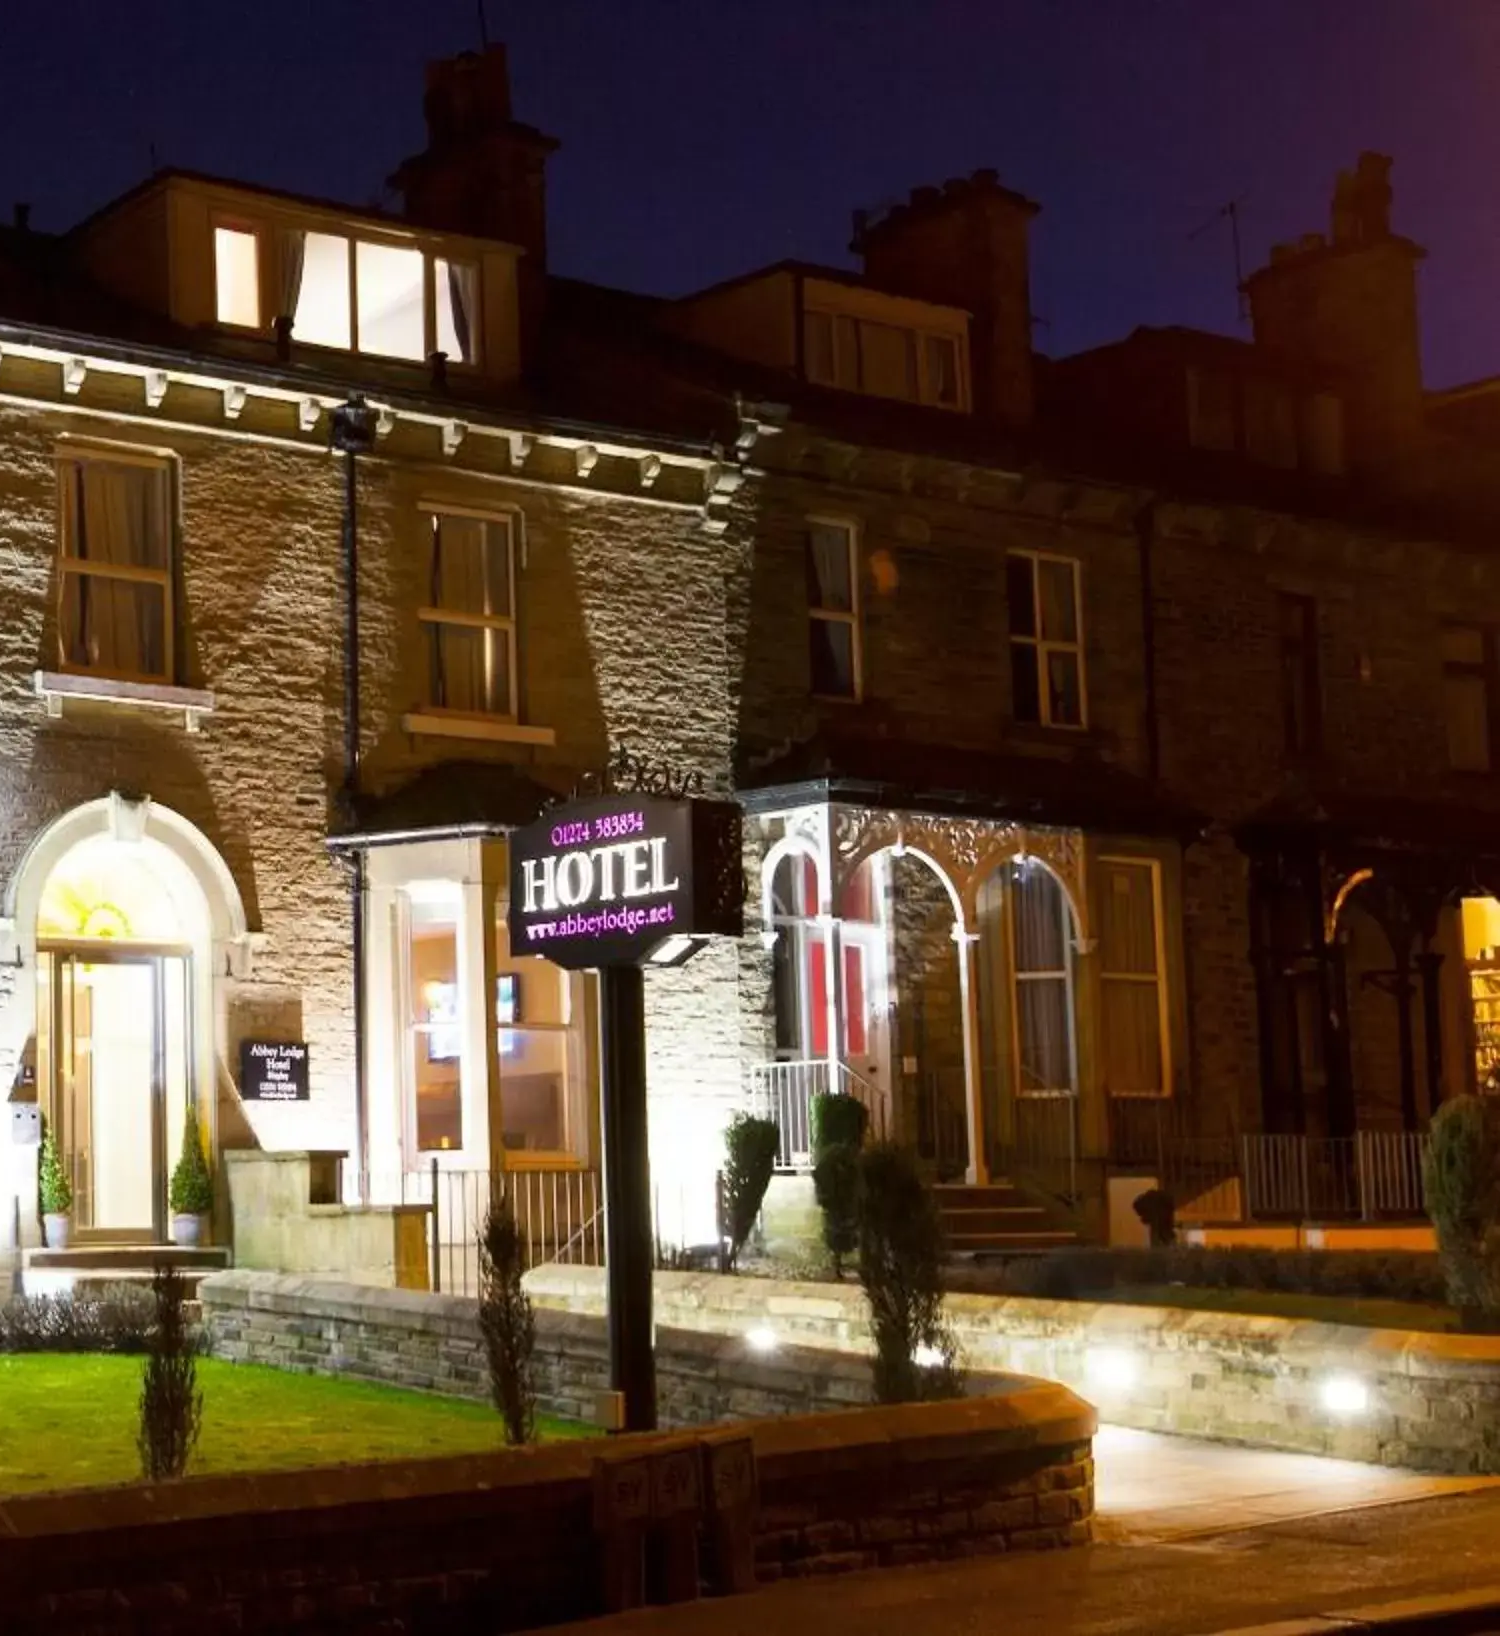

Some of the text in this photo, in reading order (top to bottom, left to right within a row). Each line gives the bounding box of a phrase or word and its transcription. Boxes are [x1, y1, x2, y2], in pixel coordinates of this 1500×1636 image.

[551, 822, 590, 846] 01274
[521, 837, 679, 913] HOTEL
[525, 901, 675, 941] www.abbeylodge.net
